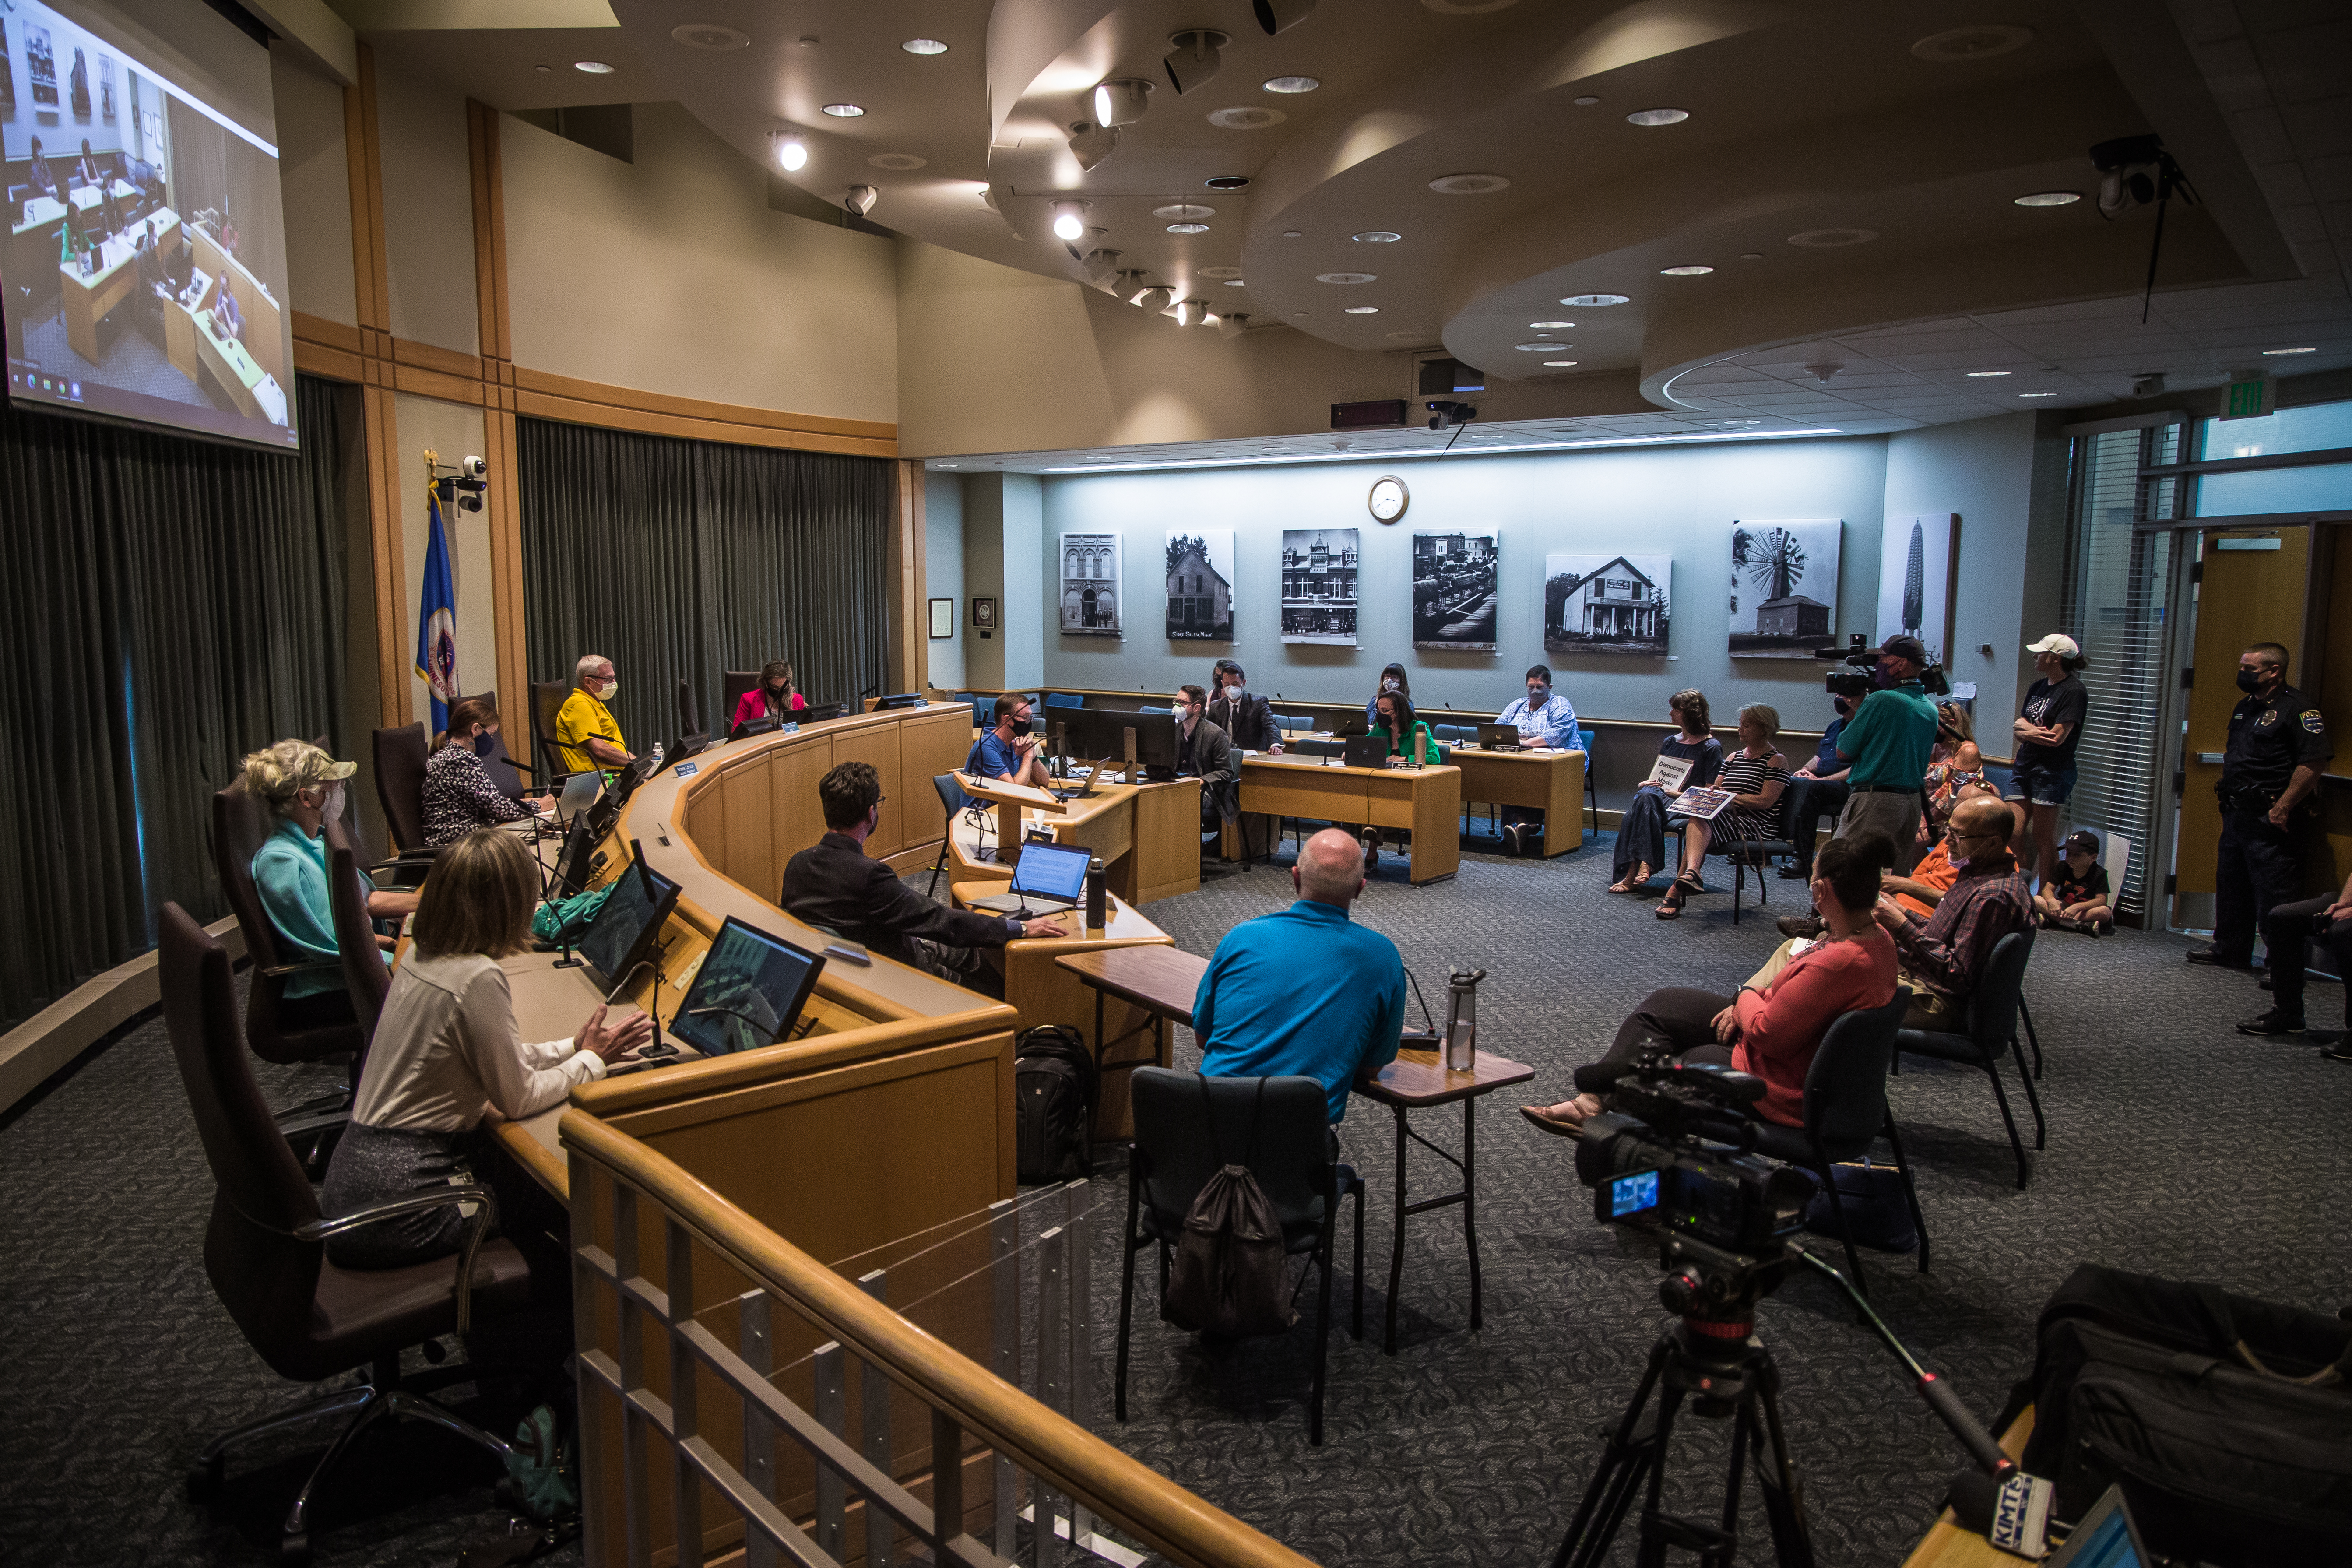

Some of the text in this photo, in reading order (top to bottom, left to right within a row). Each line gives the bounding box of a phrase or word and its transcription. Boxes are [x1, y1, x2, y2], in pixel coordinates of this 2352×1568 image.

[2230, 382, 2263, 416] EXIT
[1659, 761, 1685, 773] Democrats
[1659, 770, 1678, 779] Against
[1657, 777, 1673, 786] Masks
